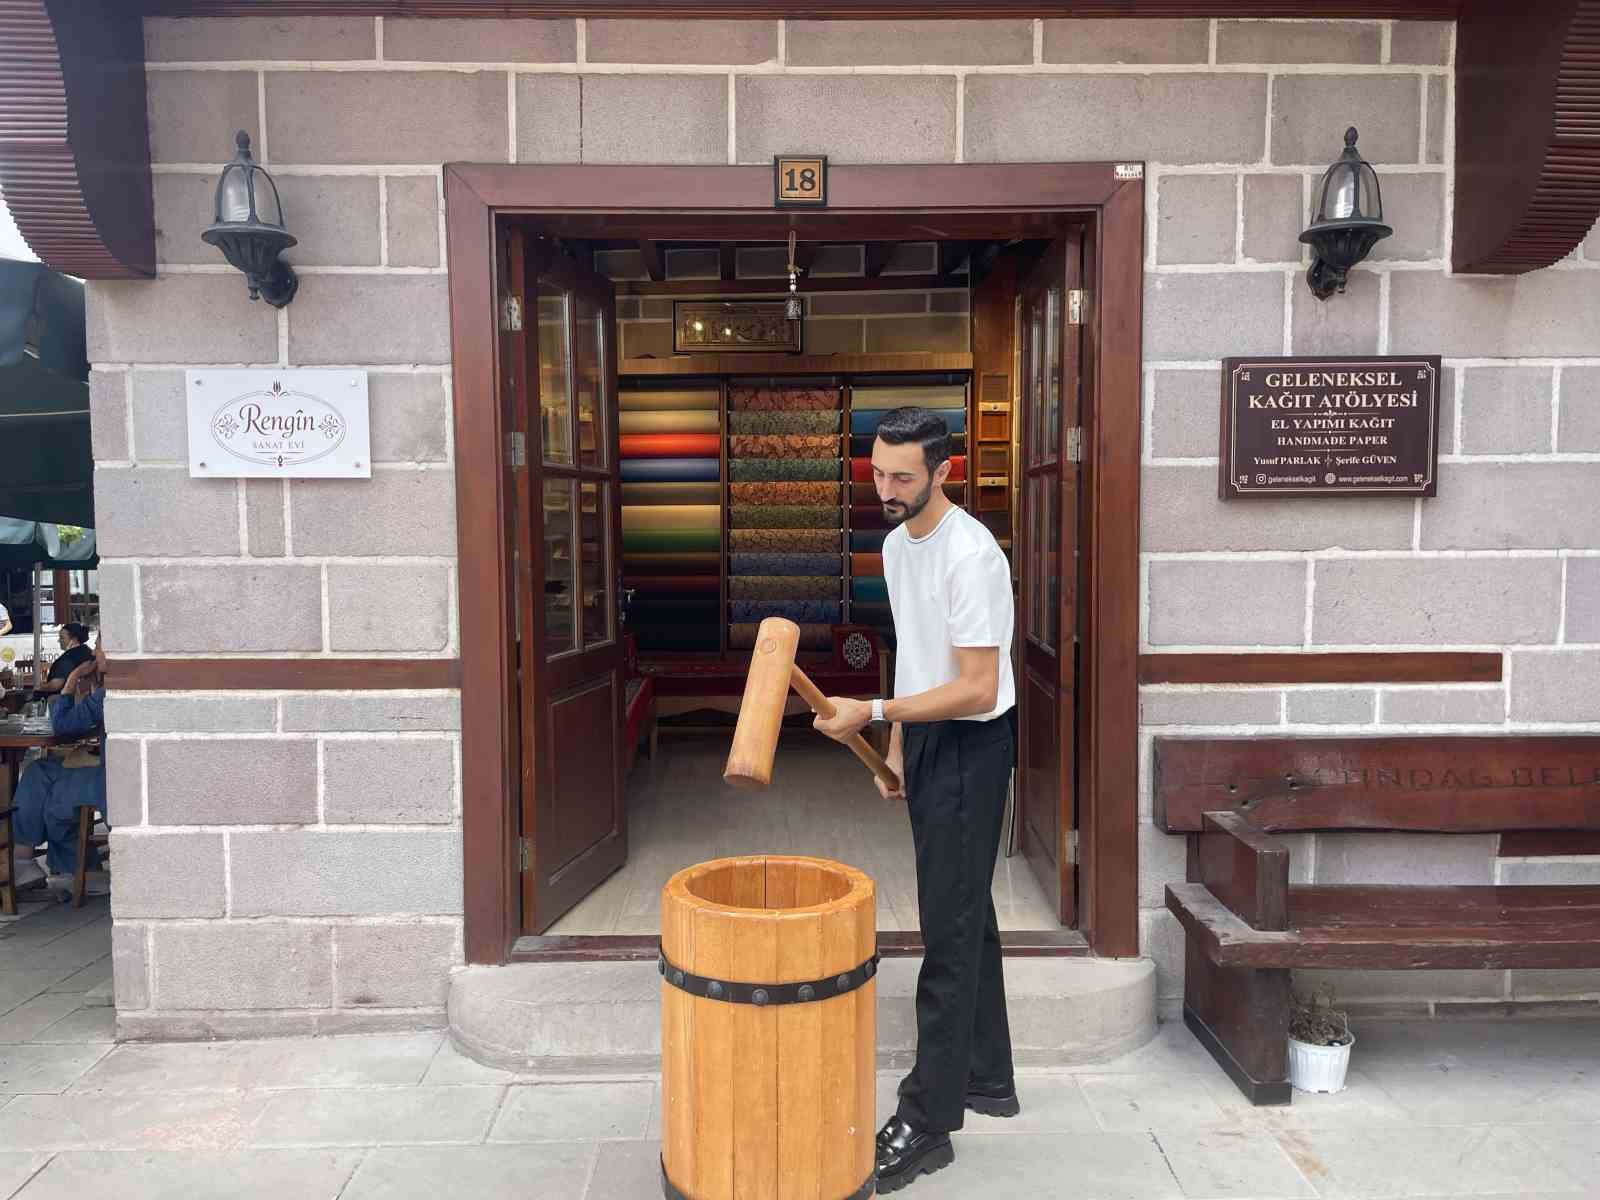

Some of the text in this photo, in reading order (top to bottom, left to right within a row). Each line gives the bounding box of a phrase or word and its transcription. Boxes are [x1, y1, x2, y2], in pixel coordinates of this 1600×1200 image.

[785, 168, 816, 191] 18
[1265, 371, 1402, 388] GELENEKSEL
[1249, 389, 1418, 409] KAĞIT ATÖLYESİ
[239, 403, 315, 439] Rengîn
[1271, 417, 1396, 430] EL YAPIMI KAĞIT
[1277, 435, 1388, 446] HANDMADE PAPER
[1254, 456, 1321, 465] Yusuf PARLAK
[1362, 454, 1398, 465] GÜVEN
